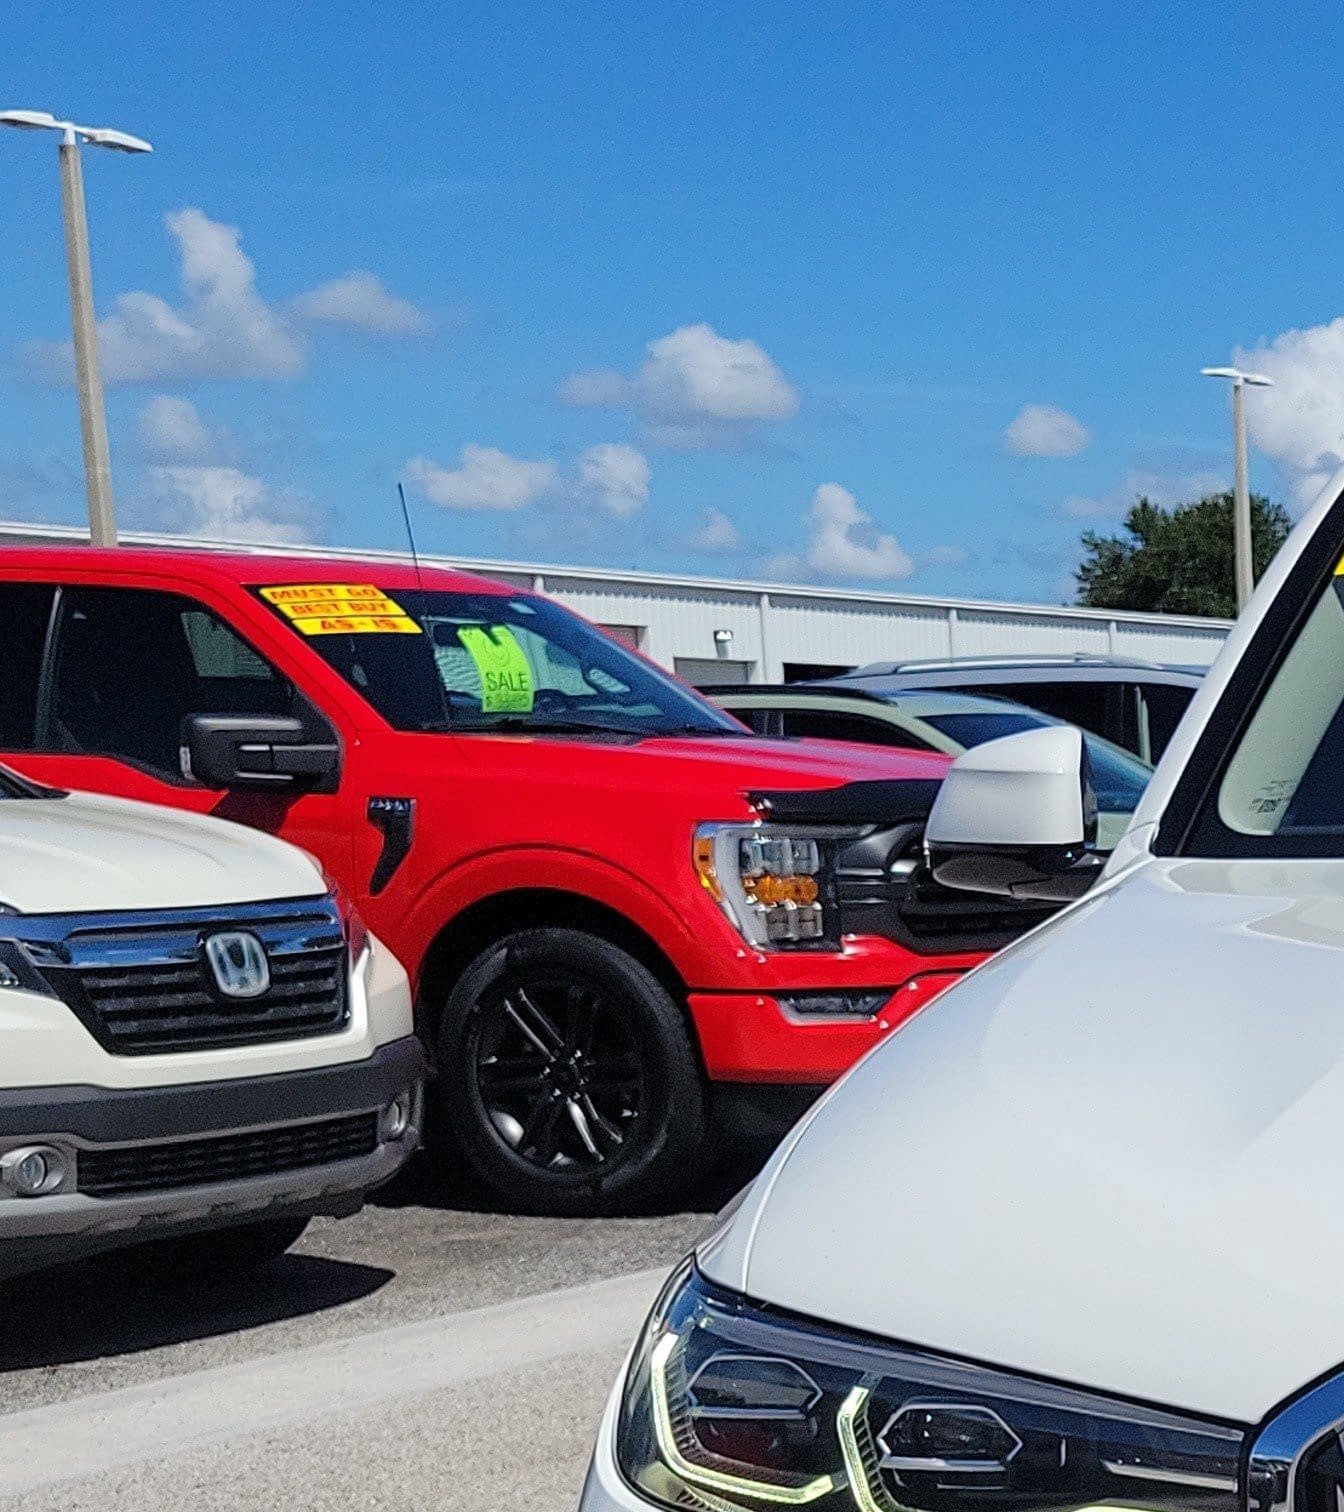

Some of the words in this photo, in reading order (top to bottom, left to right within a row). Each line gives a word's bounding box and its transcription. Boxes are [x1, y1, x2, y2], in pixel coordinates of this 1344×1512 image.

[270, 587, 335, 600] MUST
[346, 588, 378, 597] GO
[290, 603, 340, 615] BEST
[349, 602, 388, 612] BUY
[485, 671, 530, 692] SALE
